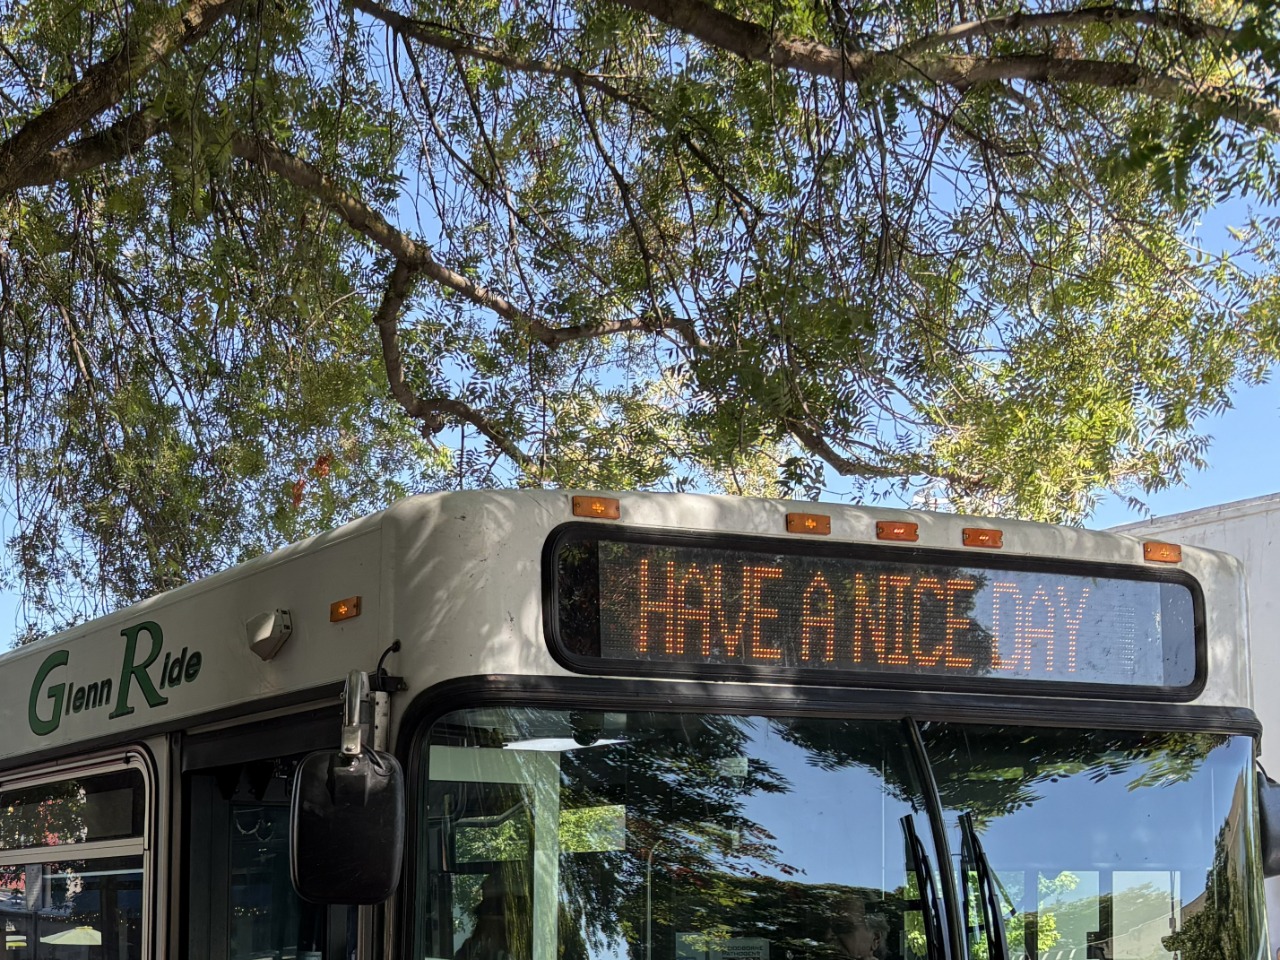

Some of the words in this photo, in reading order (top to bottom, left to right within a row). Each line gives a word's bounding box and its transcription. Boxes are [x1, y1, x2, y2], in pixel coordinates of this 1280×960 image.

[639, 558, 783, 661] HAVE
[801, 570, 835, 662] A
[853, 572, 975, 669] NICE
[990, 579, 1090, 674] DAY
[28, 649, 112, 736] Glenn
[108, 620, 202, 720] Ride
